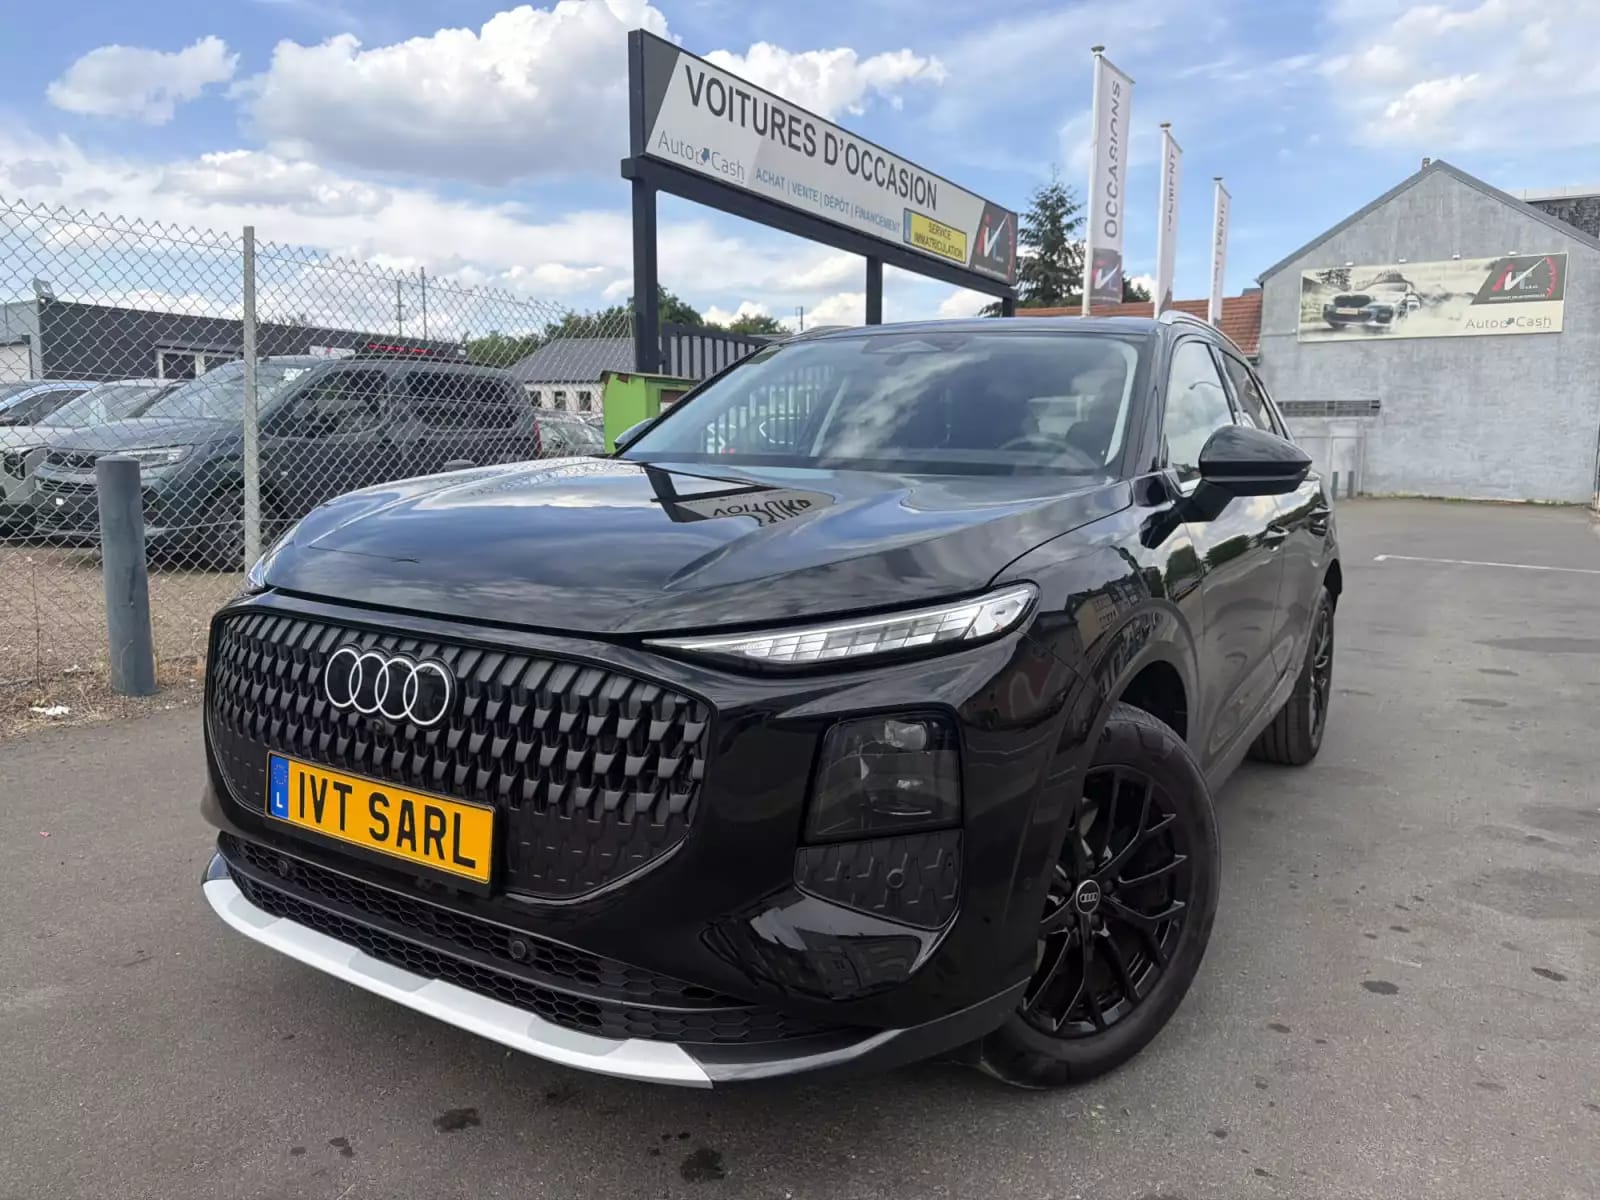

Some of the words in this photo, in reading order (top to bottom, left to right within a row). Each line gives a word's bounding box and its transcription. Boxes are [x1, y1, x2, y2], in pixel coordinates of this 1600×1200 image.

[685, 64, 817, 158] VOITURES
[824, 130, 937, 211] D'OCCASION
[1104, 80, 1122, 239] OCCASIONS
[711, 151, 745, 181] Cash
[756, 167, 785, 190] ACHAT
[791, 182, 819, 202] VENTE
[824, 193, 850, 215] DÉPÔT
[855, 205, 900, 234] FINANCEMENT
[928, 220, 952, 241] SERVICE
[1516, 315, 1552, 329] Cash
[276, 792, 283, 808] L
[300, 771, 353, 832] IVT
[368, 791, 476, 869] SARL
